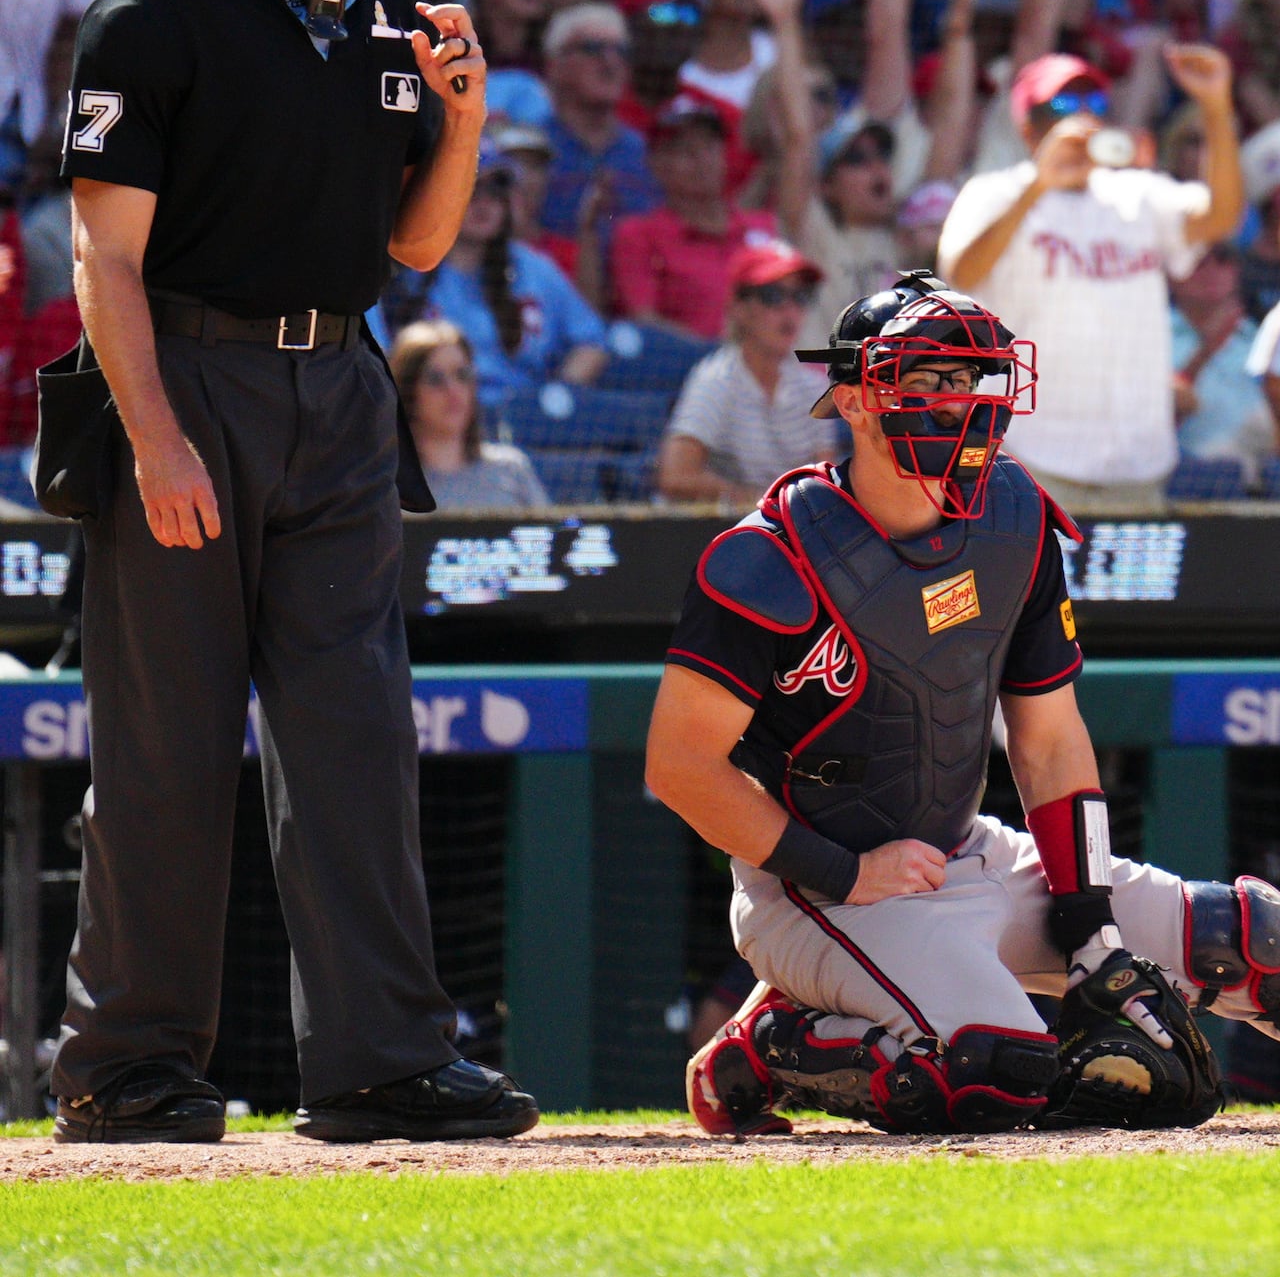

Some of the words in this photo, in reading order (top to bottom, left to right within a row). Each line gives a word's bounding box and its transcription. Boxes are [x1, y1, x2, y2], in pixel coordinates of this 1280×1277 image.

[62, 90, 124, 153] 7
[929, 536, 944, 551] 12
[928, 584, 975, 619] Rawlings
